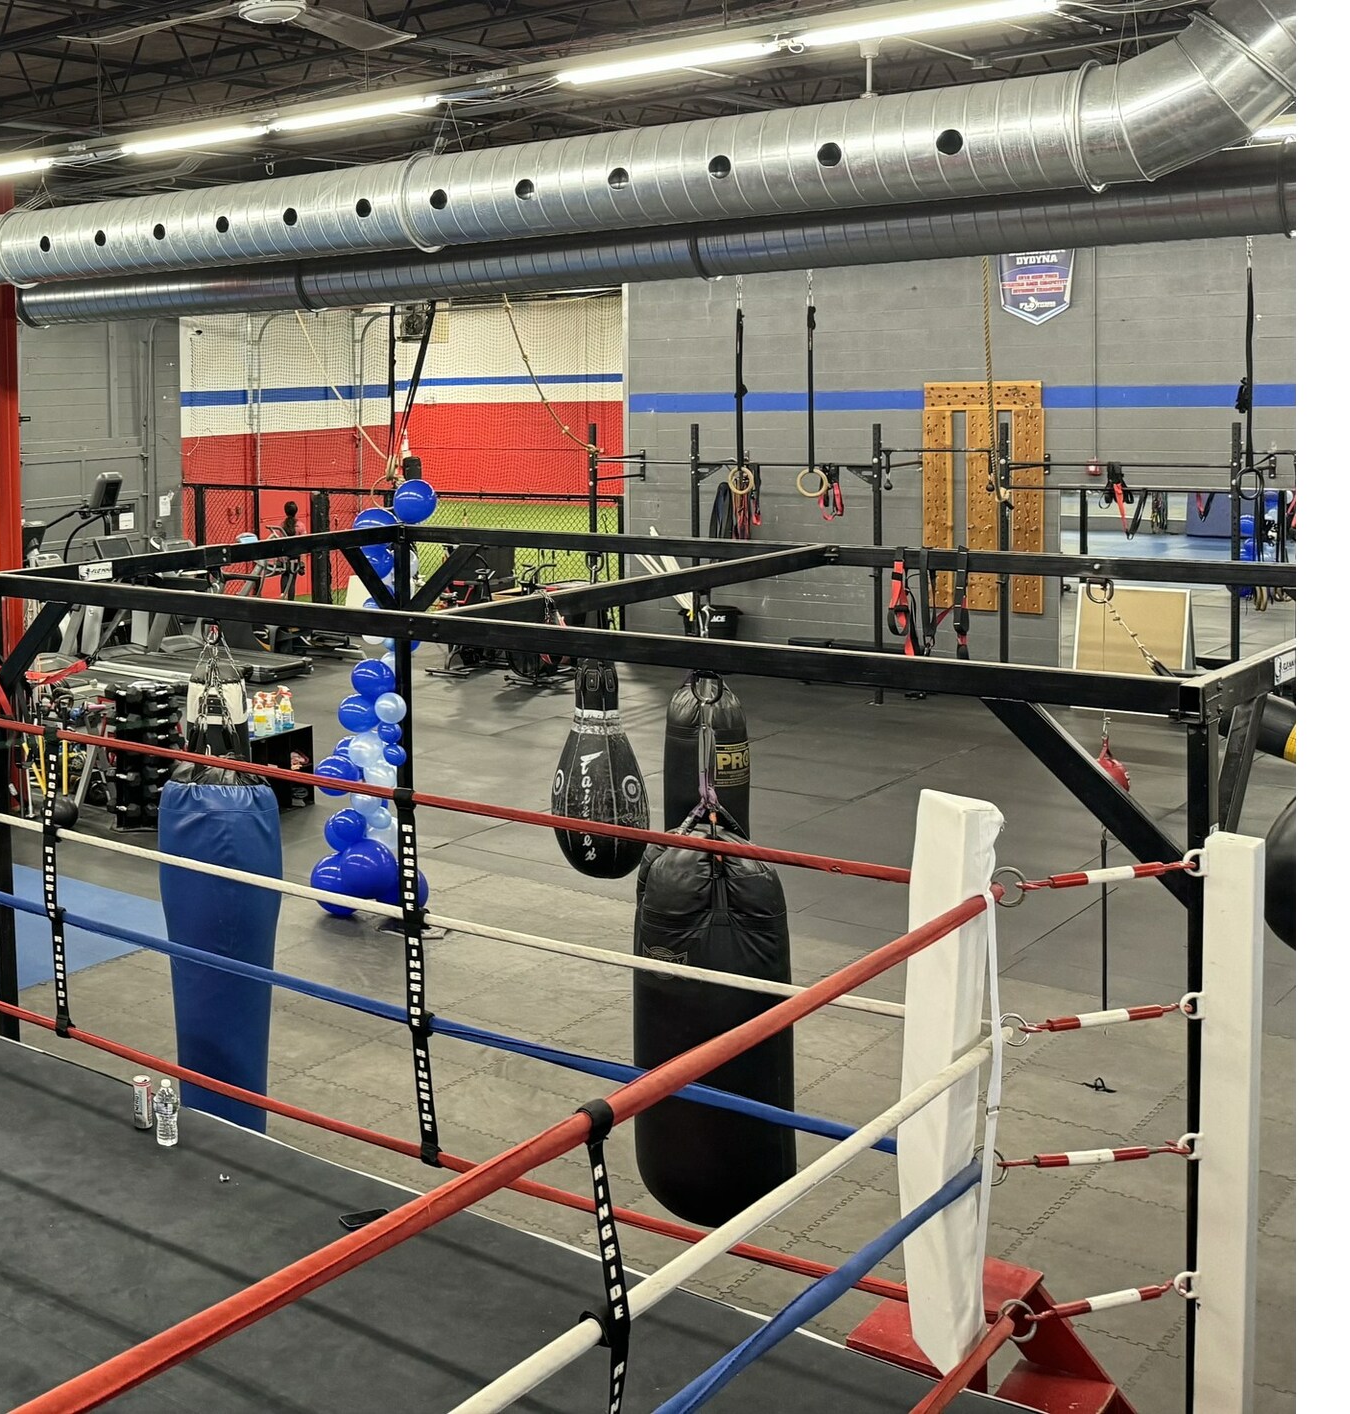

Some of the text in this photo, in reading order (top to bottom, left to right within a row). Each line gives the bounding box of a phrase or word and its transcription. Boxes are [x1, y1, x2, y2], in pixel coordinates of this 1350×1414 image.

[1016, 254, 1058, 265] DYDYNA
[710, 615, 727, 623] ACE
[45, 754, 58, 827] RINGSIDE
[579, 750, 604, 861] Fairex
[401, 824, 415, 912] RINGSIDE
[54, 935, 66, 1007] RINGSIDE
[408, 936, 421, 1028] RINGSIDE
[415, 1048, 433, 1132] RINGSIDE
[593, 1163, 625, 1321] RINGSIDE
